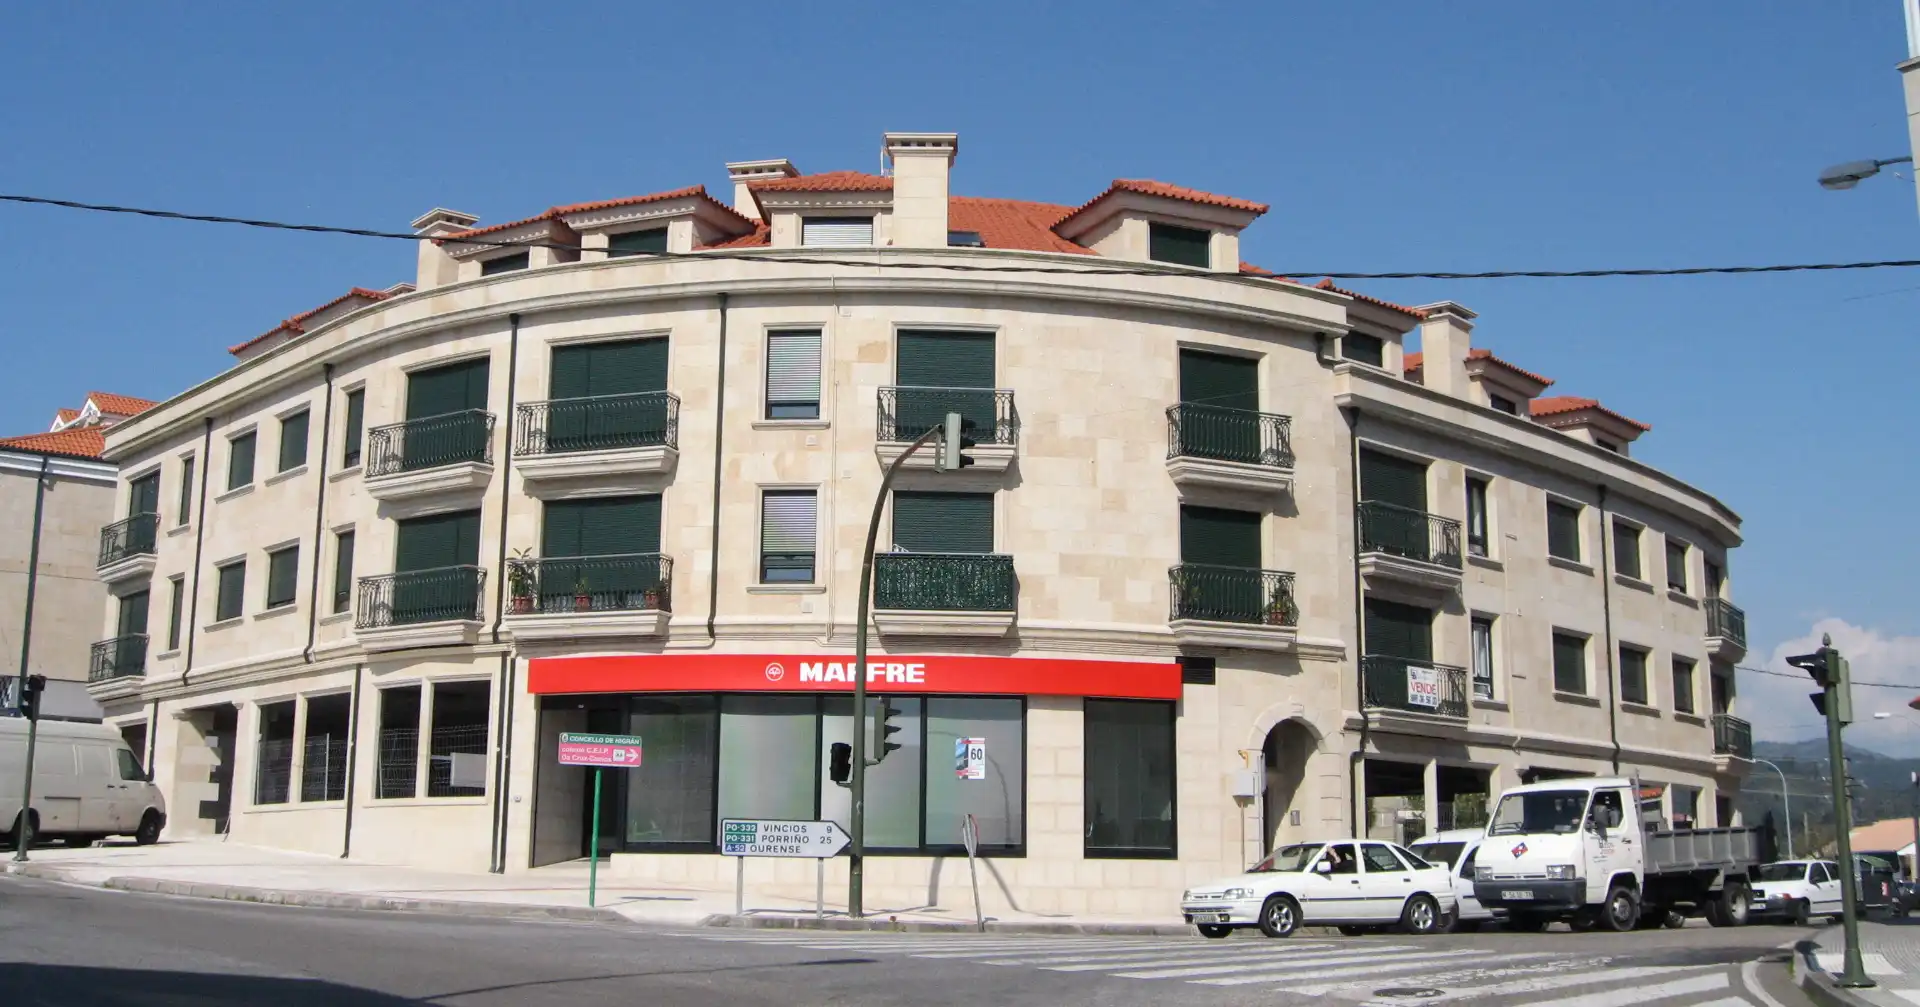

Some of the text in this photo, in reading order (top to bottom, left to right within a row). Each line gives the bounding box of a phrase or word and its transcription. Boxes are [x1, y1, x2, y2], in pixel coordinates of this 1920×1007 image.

[1410, 681, 1437, 695] VENDE
[569, 735, 604, 743] CONCELLO
[970, 748, 983, 760] 60
[726, 824, 832, 834] PO-332 VINCIOS 9
[726, 834, 832, 845] PO-331 PORRIÑO 25
[726, 844, 801, 853] A-52 OURENSE
